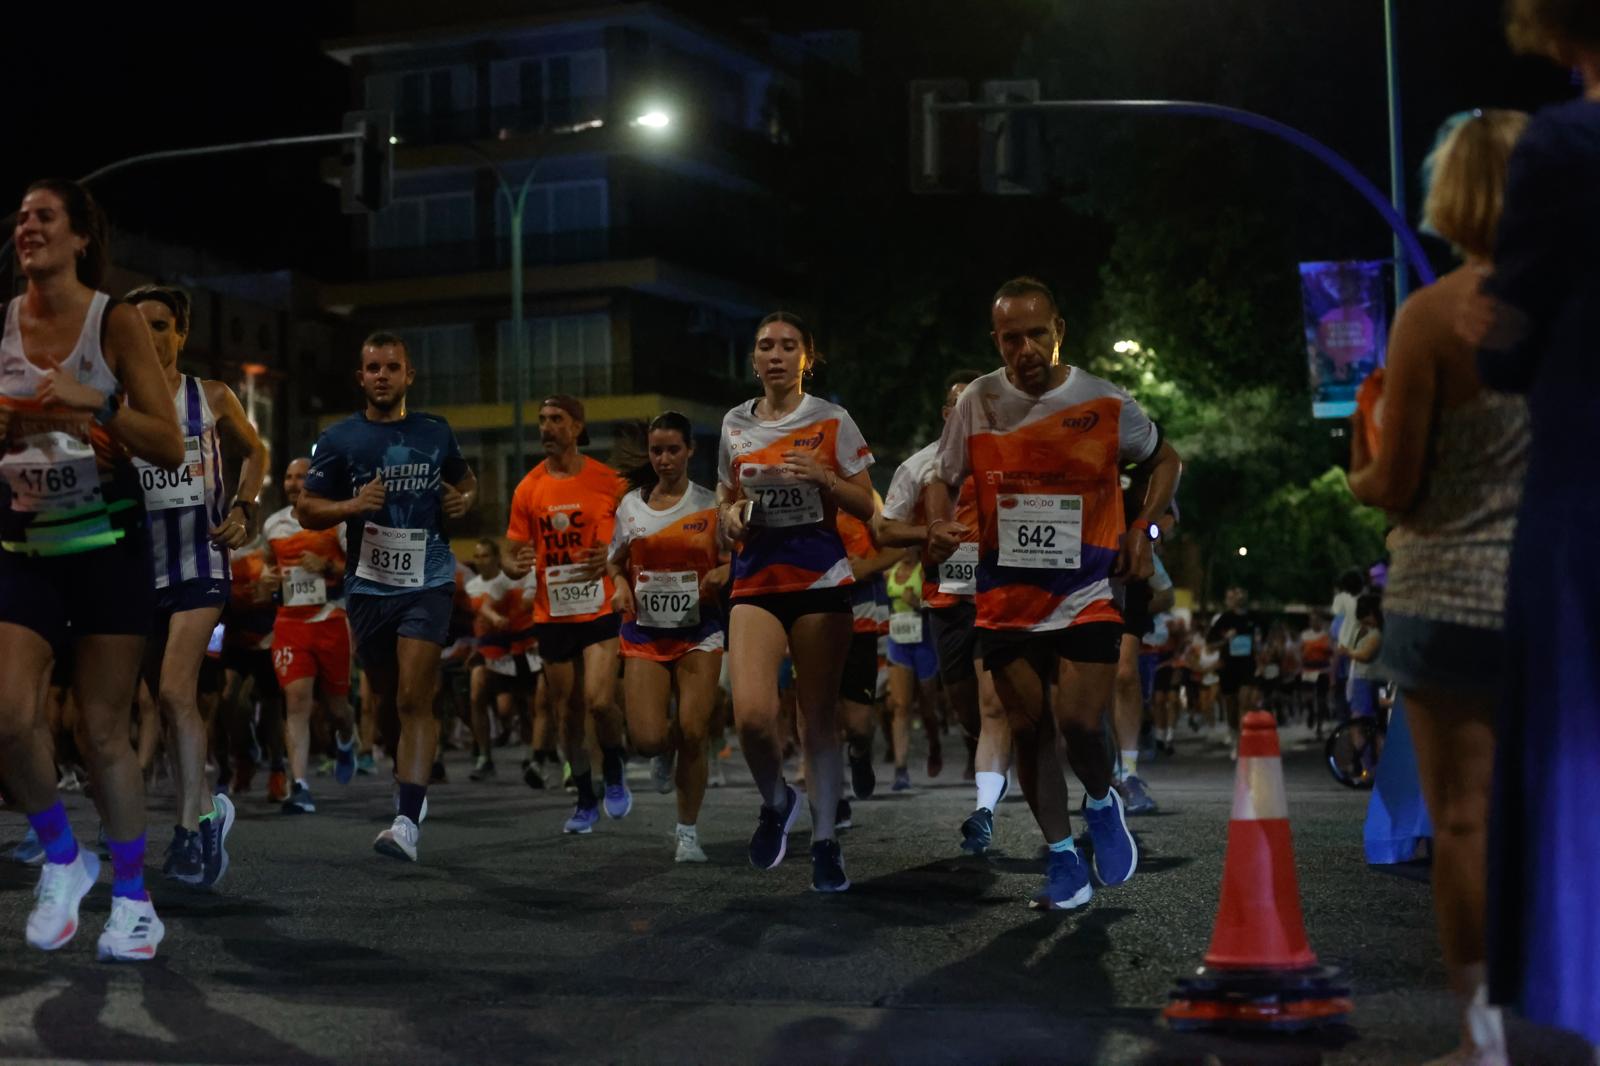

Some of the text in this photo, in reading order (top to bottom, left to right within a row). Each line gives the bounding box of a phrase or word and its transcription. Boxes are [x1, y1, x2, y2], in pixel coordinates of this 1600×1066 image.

[20, 466, 76, 492] 1768
[376, 462, 430, 478] MEDIA
[755, 488, 803, 508] 7228
[544, 532, 583, 550] TUR
[1018, 525, 1056, 547] 642
[371, 548, 411, 570] 8318
[553, 583, 599, 601] 13947
[642, 594, 690, 612] 16702
